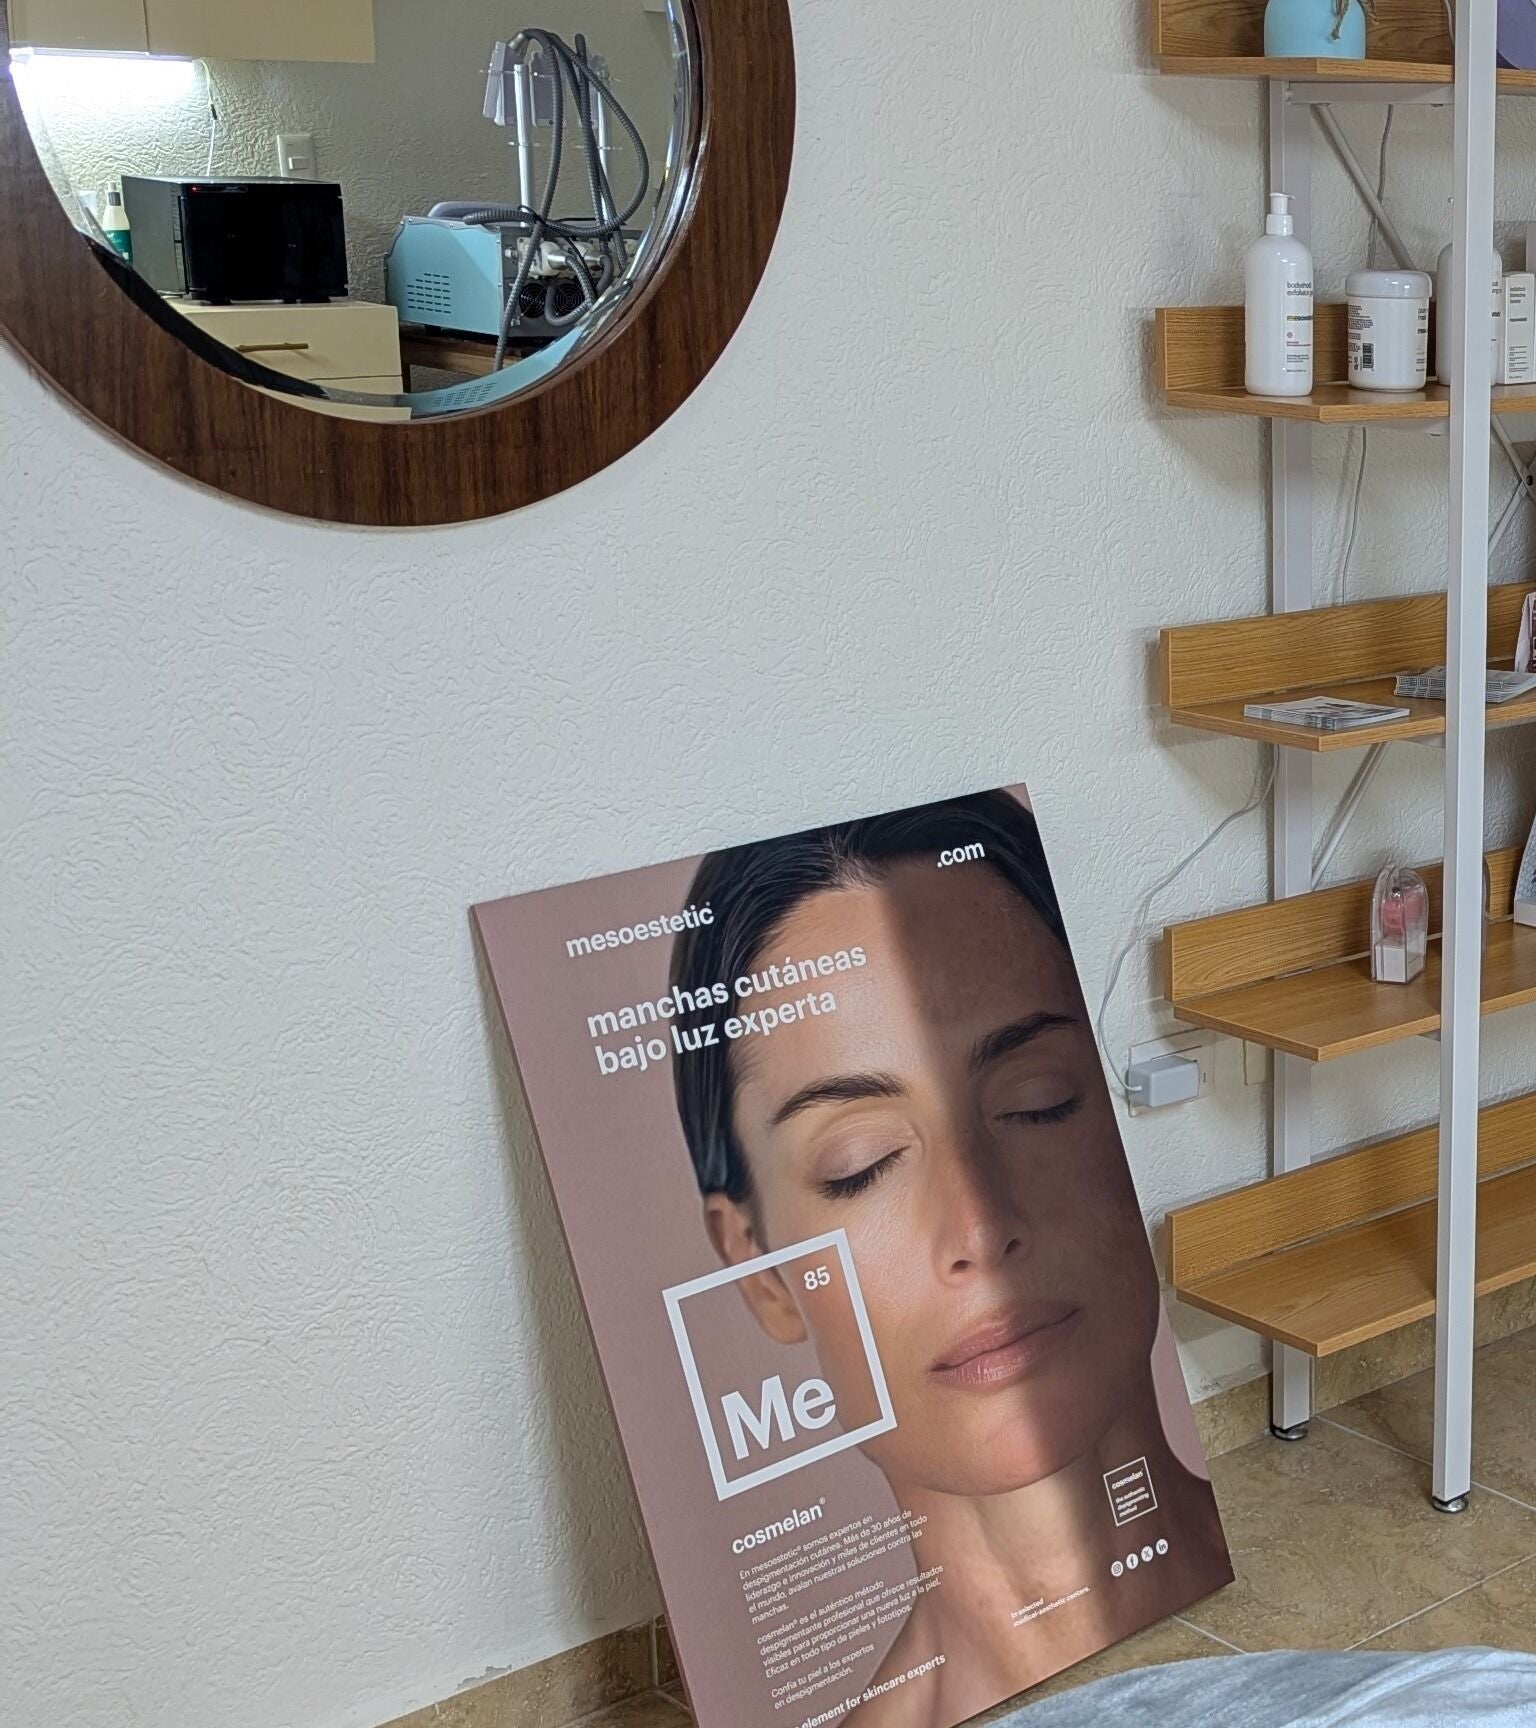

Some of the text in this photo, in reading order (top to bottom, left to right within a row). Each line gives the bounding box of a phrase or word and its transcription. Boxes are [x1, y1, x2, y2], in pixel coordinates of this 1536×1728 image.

[937, 842, 986, 868] .com
[587, 945, 868, 1037] manchas cutáneas
[594, 990, 837, 1076] bajo luz experta
[803, 1265, 831, 1291] 85
[721, 1374, 837, 1461] Me
[845, 1695, 862, 1710] for
[862, 1674, 906, 1702] skincare
[906, 1654, 946, 1680] experts
